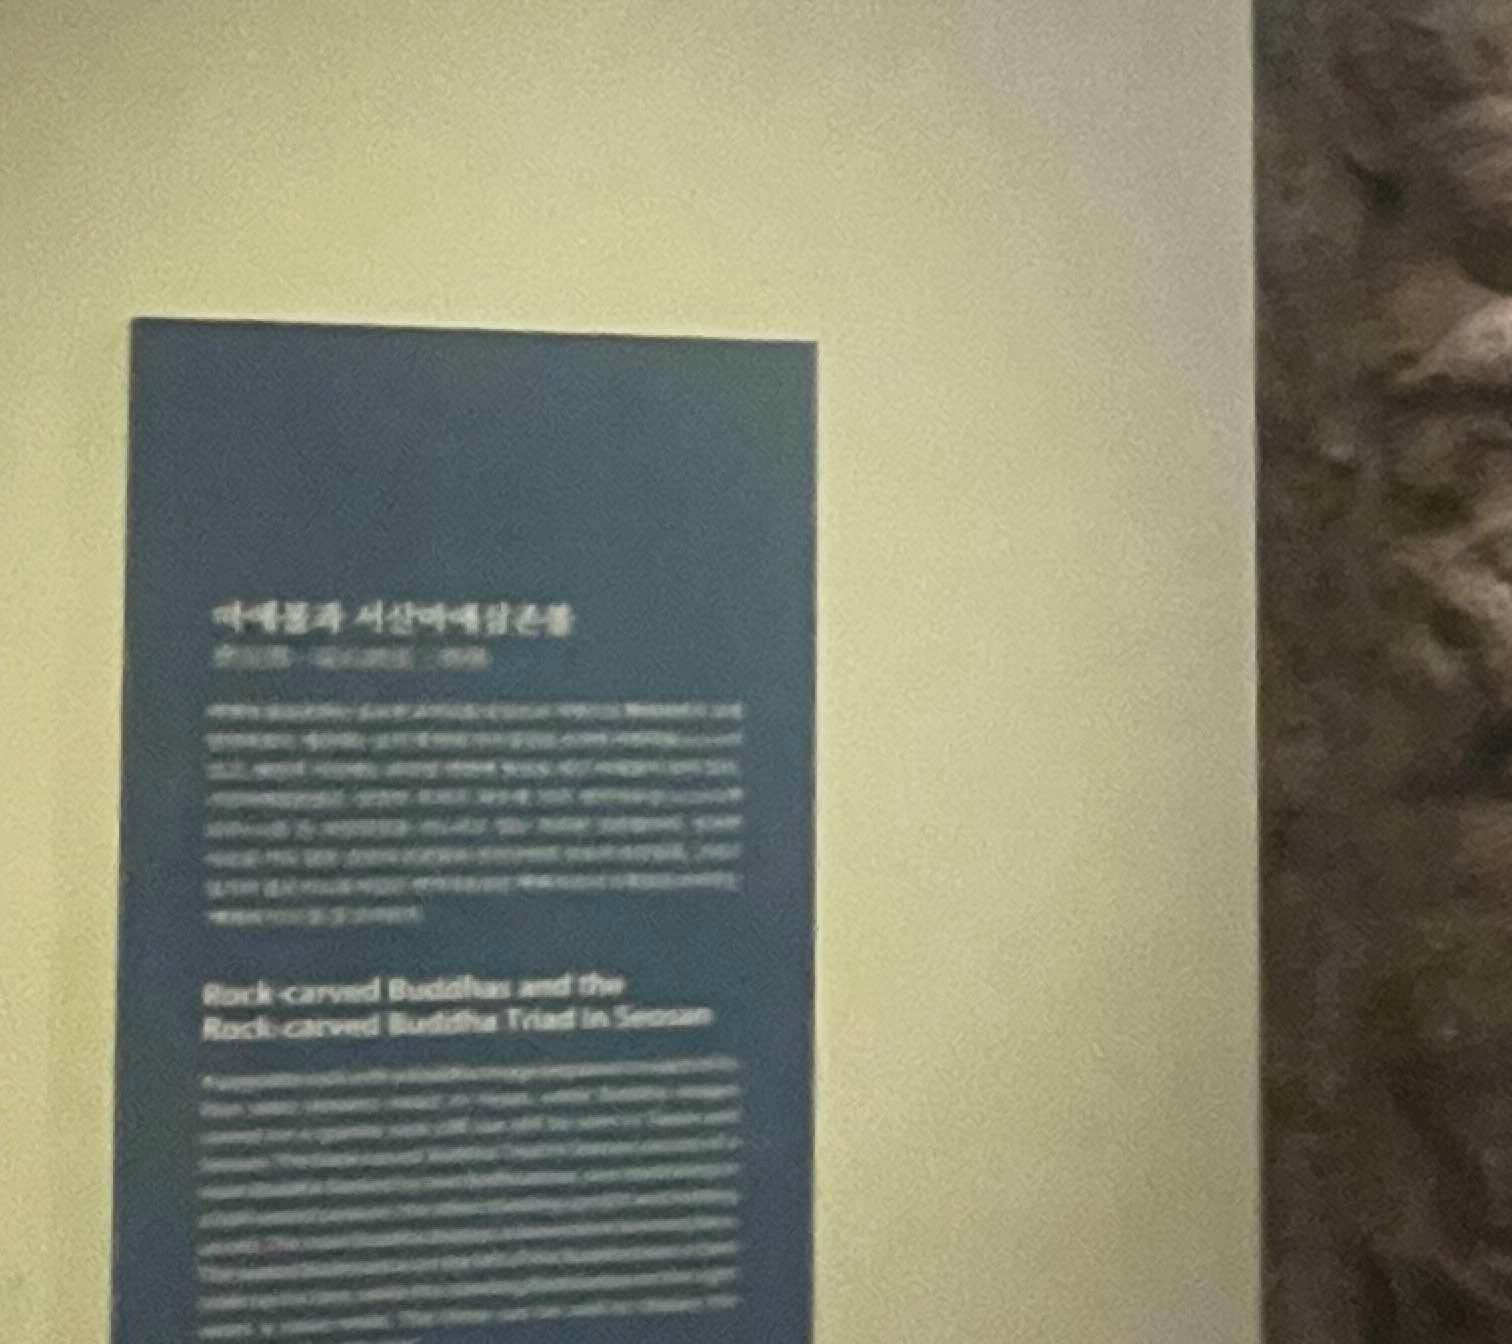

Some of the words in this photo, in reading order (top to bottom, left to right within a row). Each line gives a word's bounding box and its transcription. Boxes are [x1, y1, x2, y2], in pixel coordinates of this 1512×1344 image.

[203, 976, 380, 1006] Rock-carved
[388, 973, 511, 1002] Buddhas
[518, 971, 572, 998] and
[577, 970, 625, 997] the
[203, 1013, 380, 1043] Rock-carved
[388, 1010, 497, 1038] Buddha
[507, 1007, 576, 1032] Triad
[582, 1006, 611, 1030] in
[614, 1005, 713, 1030] Seosan
